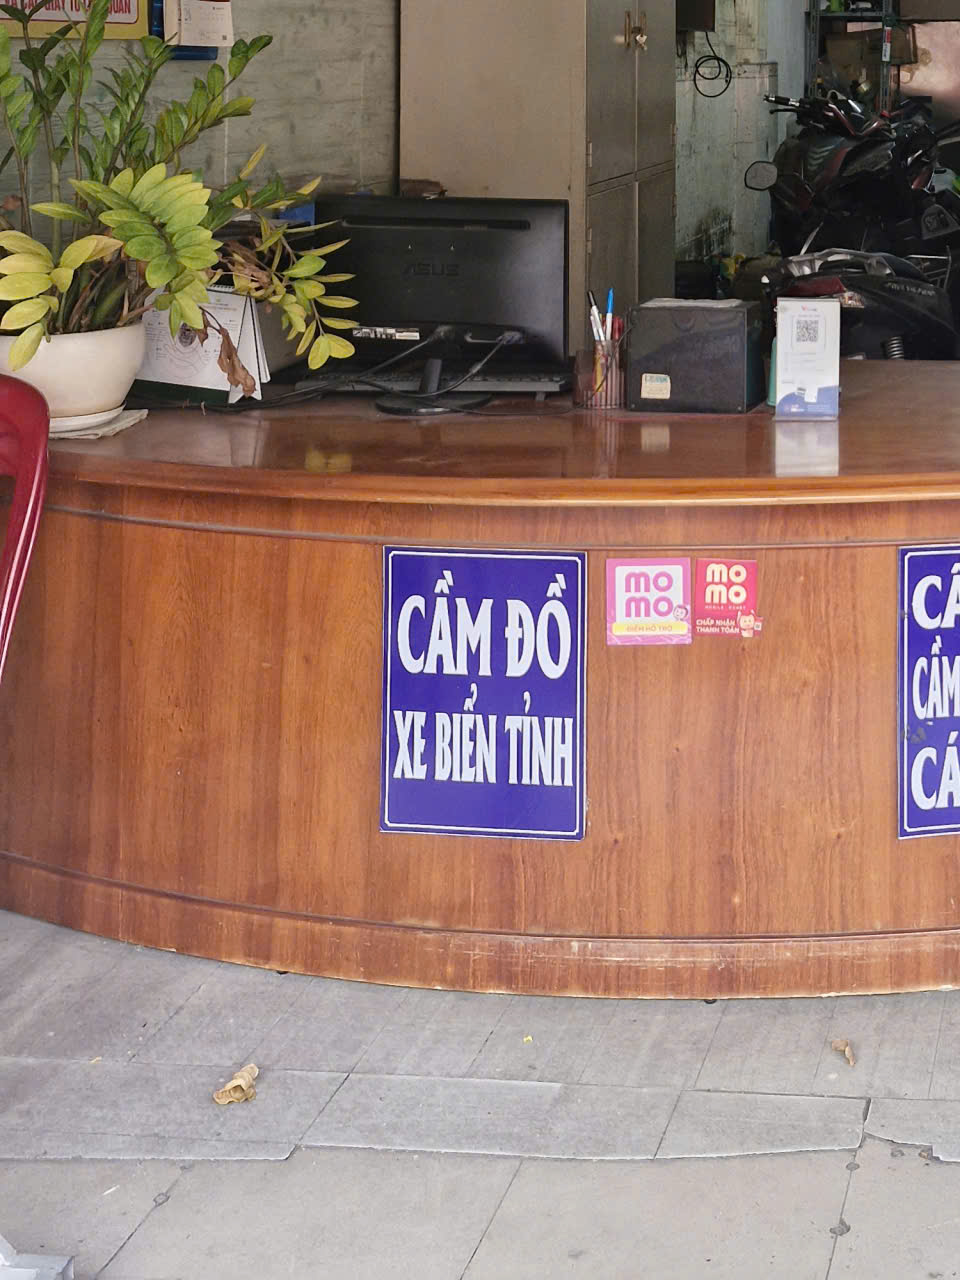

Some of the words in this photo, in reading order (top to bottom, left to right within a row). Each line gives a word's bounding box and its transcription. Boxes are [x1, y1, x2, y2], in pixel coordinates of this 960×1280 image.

[397, 570, 493, 676] CẦM
[504, 573, 572, 680] ĐỒ
[393, 710, 427, 780] XE
[434, 683, 497, 784] BIỂN
[504, 691, 574, 787] TỈNH
